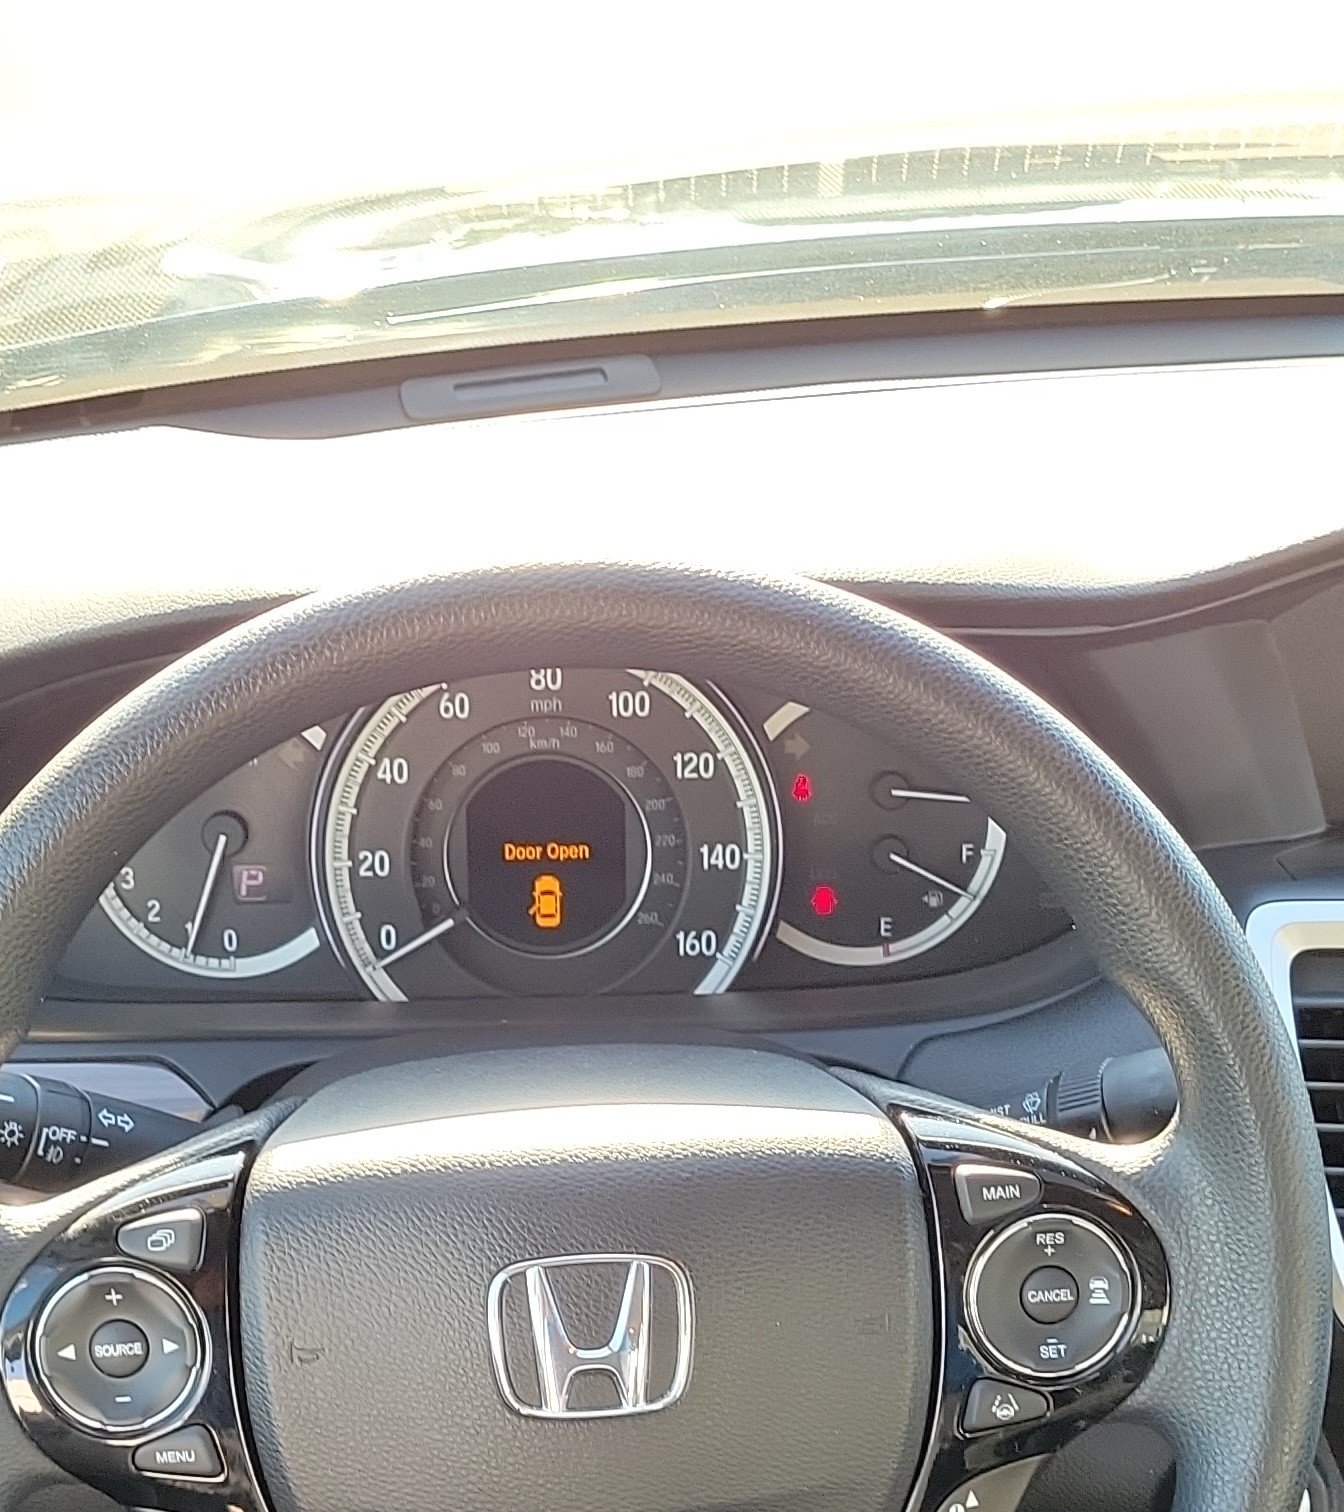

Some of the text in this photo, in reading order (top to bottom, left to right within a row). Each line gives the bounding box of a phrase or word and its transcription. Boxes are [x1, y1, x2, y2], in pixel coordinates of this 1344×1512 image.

[529, 667, 563, 691] 80
[438, 691, 470, 720] 60
[530, 698, 563, 714] mph
[607, 690, 651, 718] 100
[376, 757, 409, 785] 40
[672, 751, 715, 780] 120
[357, 849, 391, 878] 20
[503, 841, 590, 864] Door Open
[699, 843, 741, 871] 140
[961, 843, 974, 864] F
[120, 866, 135, 890] 3
[240, 869, 264, 897] P
[146, 899, 161, 923] 2
[379, 924, 397, 951] 0
[880, 917, 893, 937] E
[223, 928, 238, 952] 0
[675, 929, 717, 957] 160
[48, 1125, 77, 1144] OFF
[982, 1184, 1021, 1202] MAIN
[1036, 1232, 1065, 1246] RES
[1027, 1289, 1075, 1303] CANCEL
[94, 1341, 143, 1358] SOURCE
[1039, 1344, 1067, 1359] SET
[155, 1449, 196, 1464] MENU
